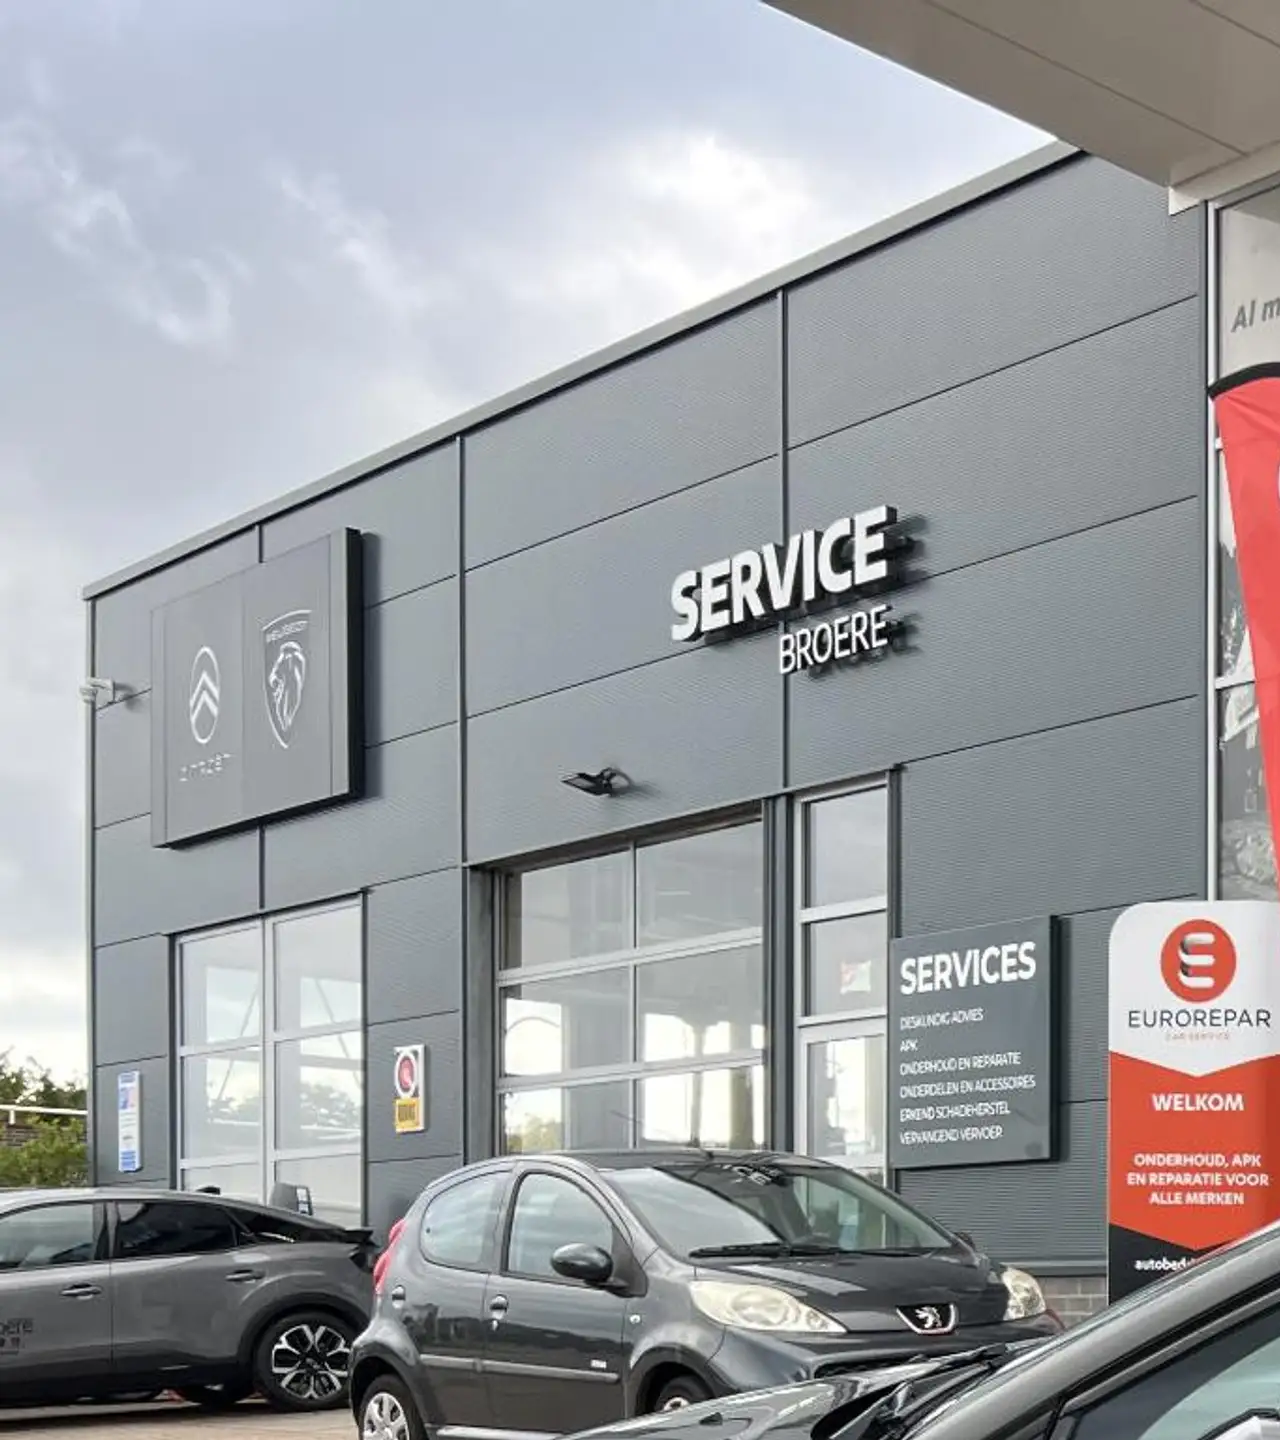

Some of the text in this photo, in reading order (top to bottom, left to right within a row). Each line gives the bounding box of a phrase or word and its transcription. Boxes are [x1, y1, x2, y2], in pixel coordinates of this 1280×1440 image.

[1231, 305, 1256, 333] Al
[671, 505, 892, 641] SERVICE
[779, 604, 889, 676] BROERE
[900, 941, 1037, 996] SERVICES
[1128, 1008, 1272, 1029] EUROREPAR
[1152, 1092, 1245, 1112] WELKOM
[1133, 1152, 1262, 1169] ONDERHOUD, APK
[1126, 1172, 1270, 1187] EN REPARATIE VOOR
[1149, 1191, 1245, 1206] ALLE MERKEN
